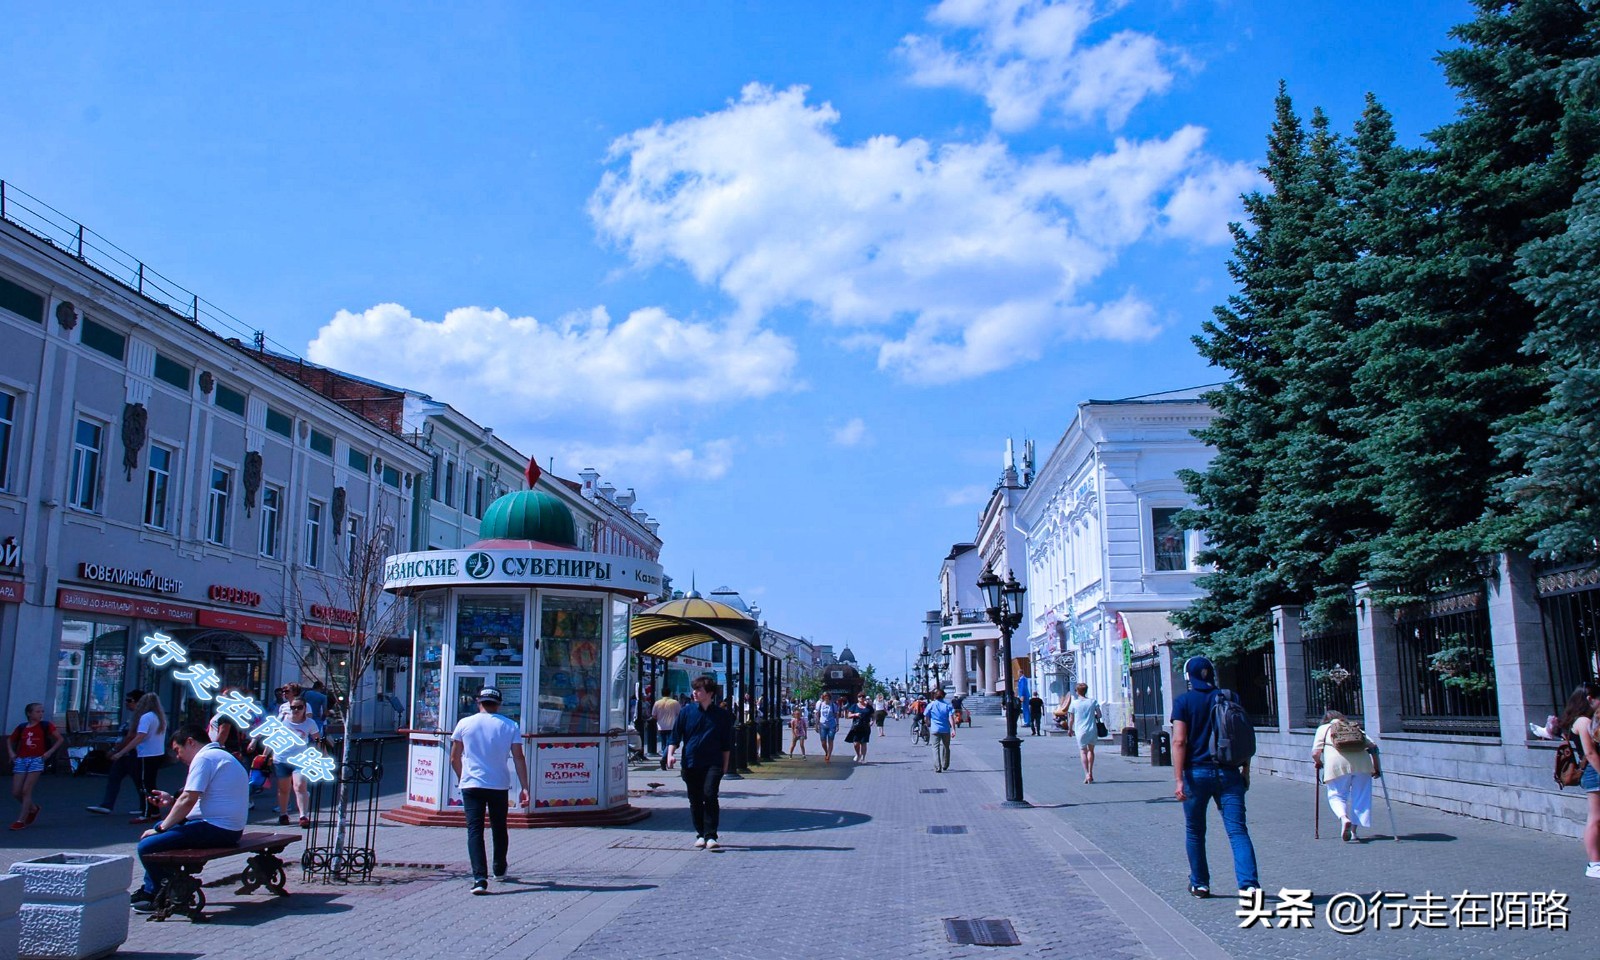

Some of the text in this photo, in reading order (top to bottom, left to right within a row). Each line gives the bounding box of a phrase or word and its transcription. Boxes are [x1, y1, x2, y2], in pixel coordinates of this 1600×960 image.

[84, 562, 184, 593] ЮВЕЛИРНЫЙ ЦЕНТР
[502, 557, 612, 580] СУВЕНИРЫ
[212, 585, 262, 606] СЕРЕБРО
